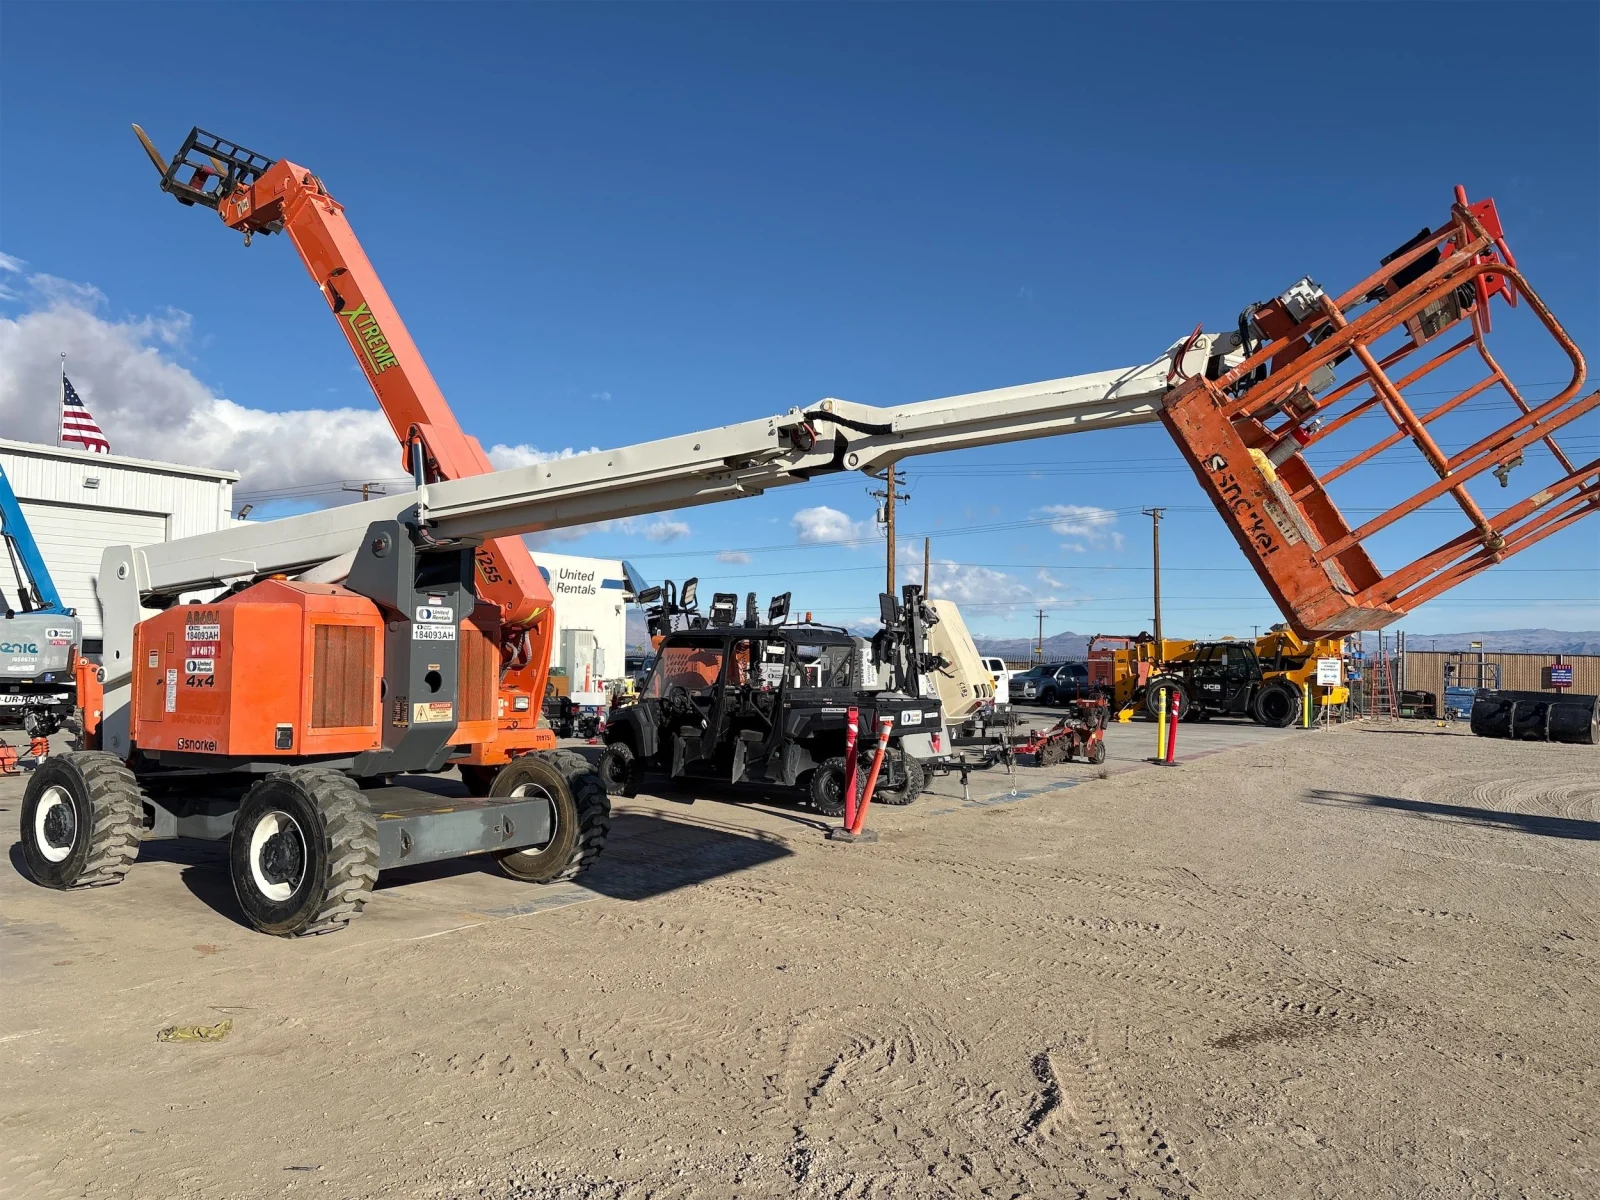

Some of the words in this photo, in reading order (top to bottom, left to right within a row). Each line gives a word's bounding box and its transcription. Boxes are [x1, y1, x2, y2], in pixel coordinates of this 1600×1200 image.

[339, 301, 399, 373] XTREME
[359, 353, 383, 397] MANUFACTURING
[475, 549, 503, 583] 1255
[559, 567, 595, 582] United
[556, 582, 597, 595] Rentals
[186, 631, 219, 640] 184093AH
[415, 630, 454, 640] 184093AH
[186, 674, 214, 688] 4x4
[184, 738, 218, 752] snorkel
